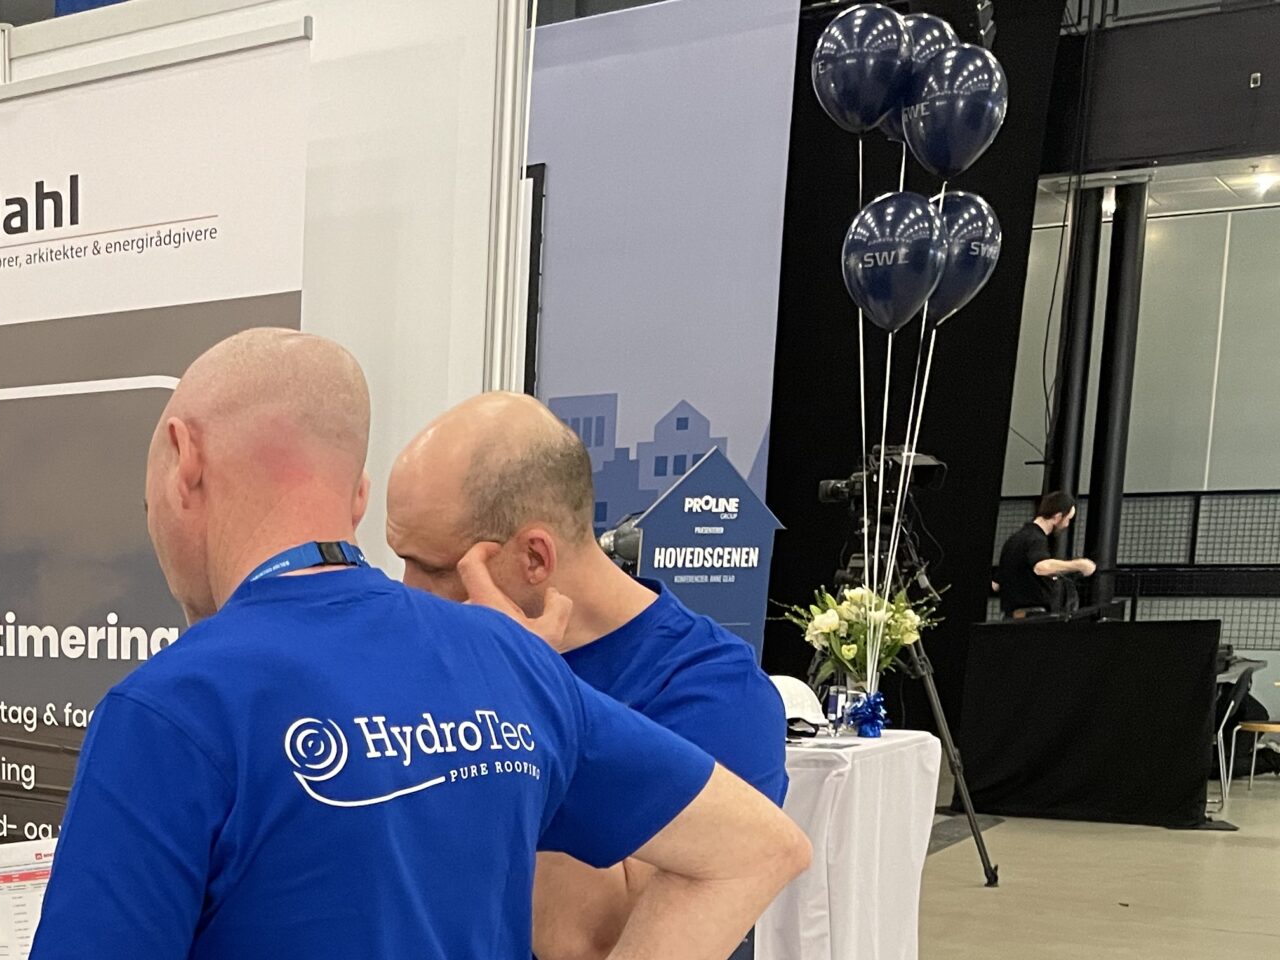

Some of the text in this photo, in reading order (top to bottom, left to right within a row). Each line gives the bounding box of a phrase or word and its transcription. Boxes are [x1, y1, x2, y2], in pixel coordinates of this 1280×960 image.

[25, 243, 89, 265] arkitekter
[92, 241, 101, 256] &
[105, 225, 218, 256] energirådgivere
[684, 495, 740, 513] PROLINE
[653, 547, 759, 568] HOVEDSCENEN
[0, 704, 37, 732] tag
[43, 703, 59, 726] &
[353, 709, 535, 766] HydroTec
[449, 763, 489, 782] PURE
